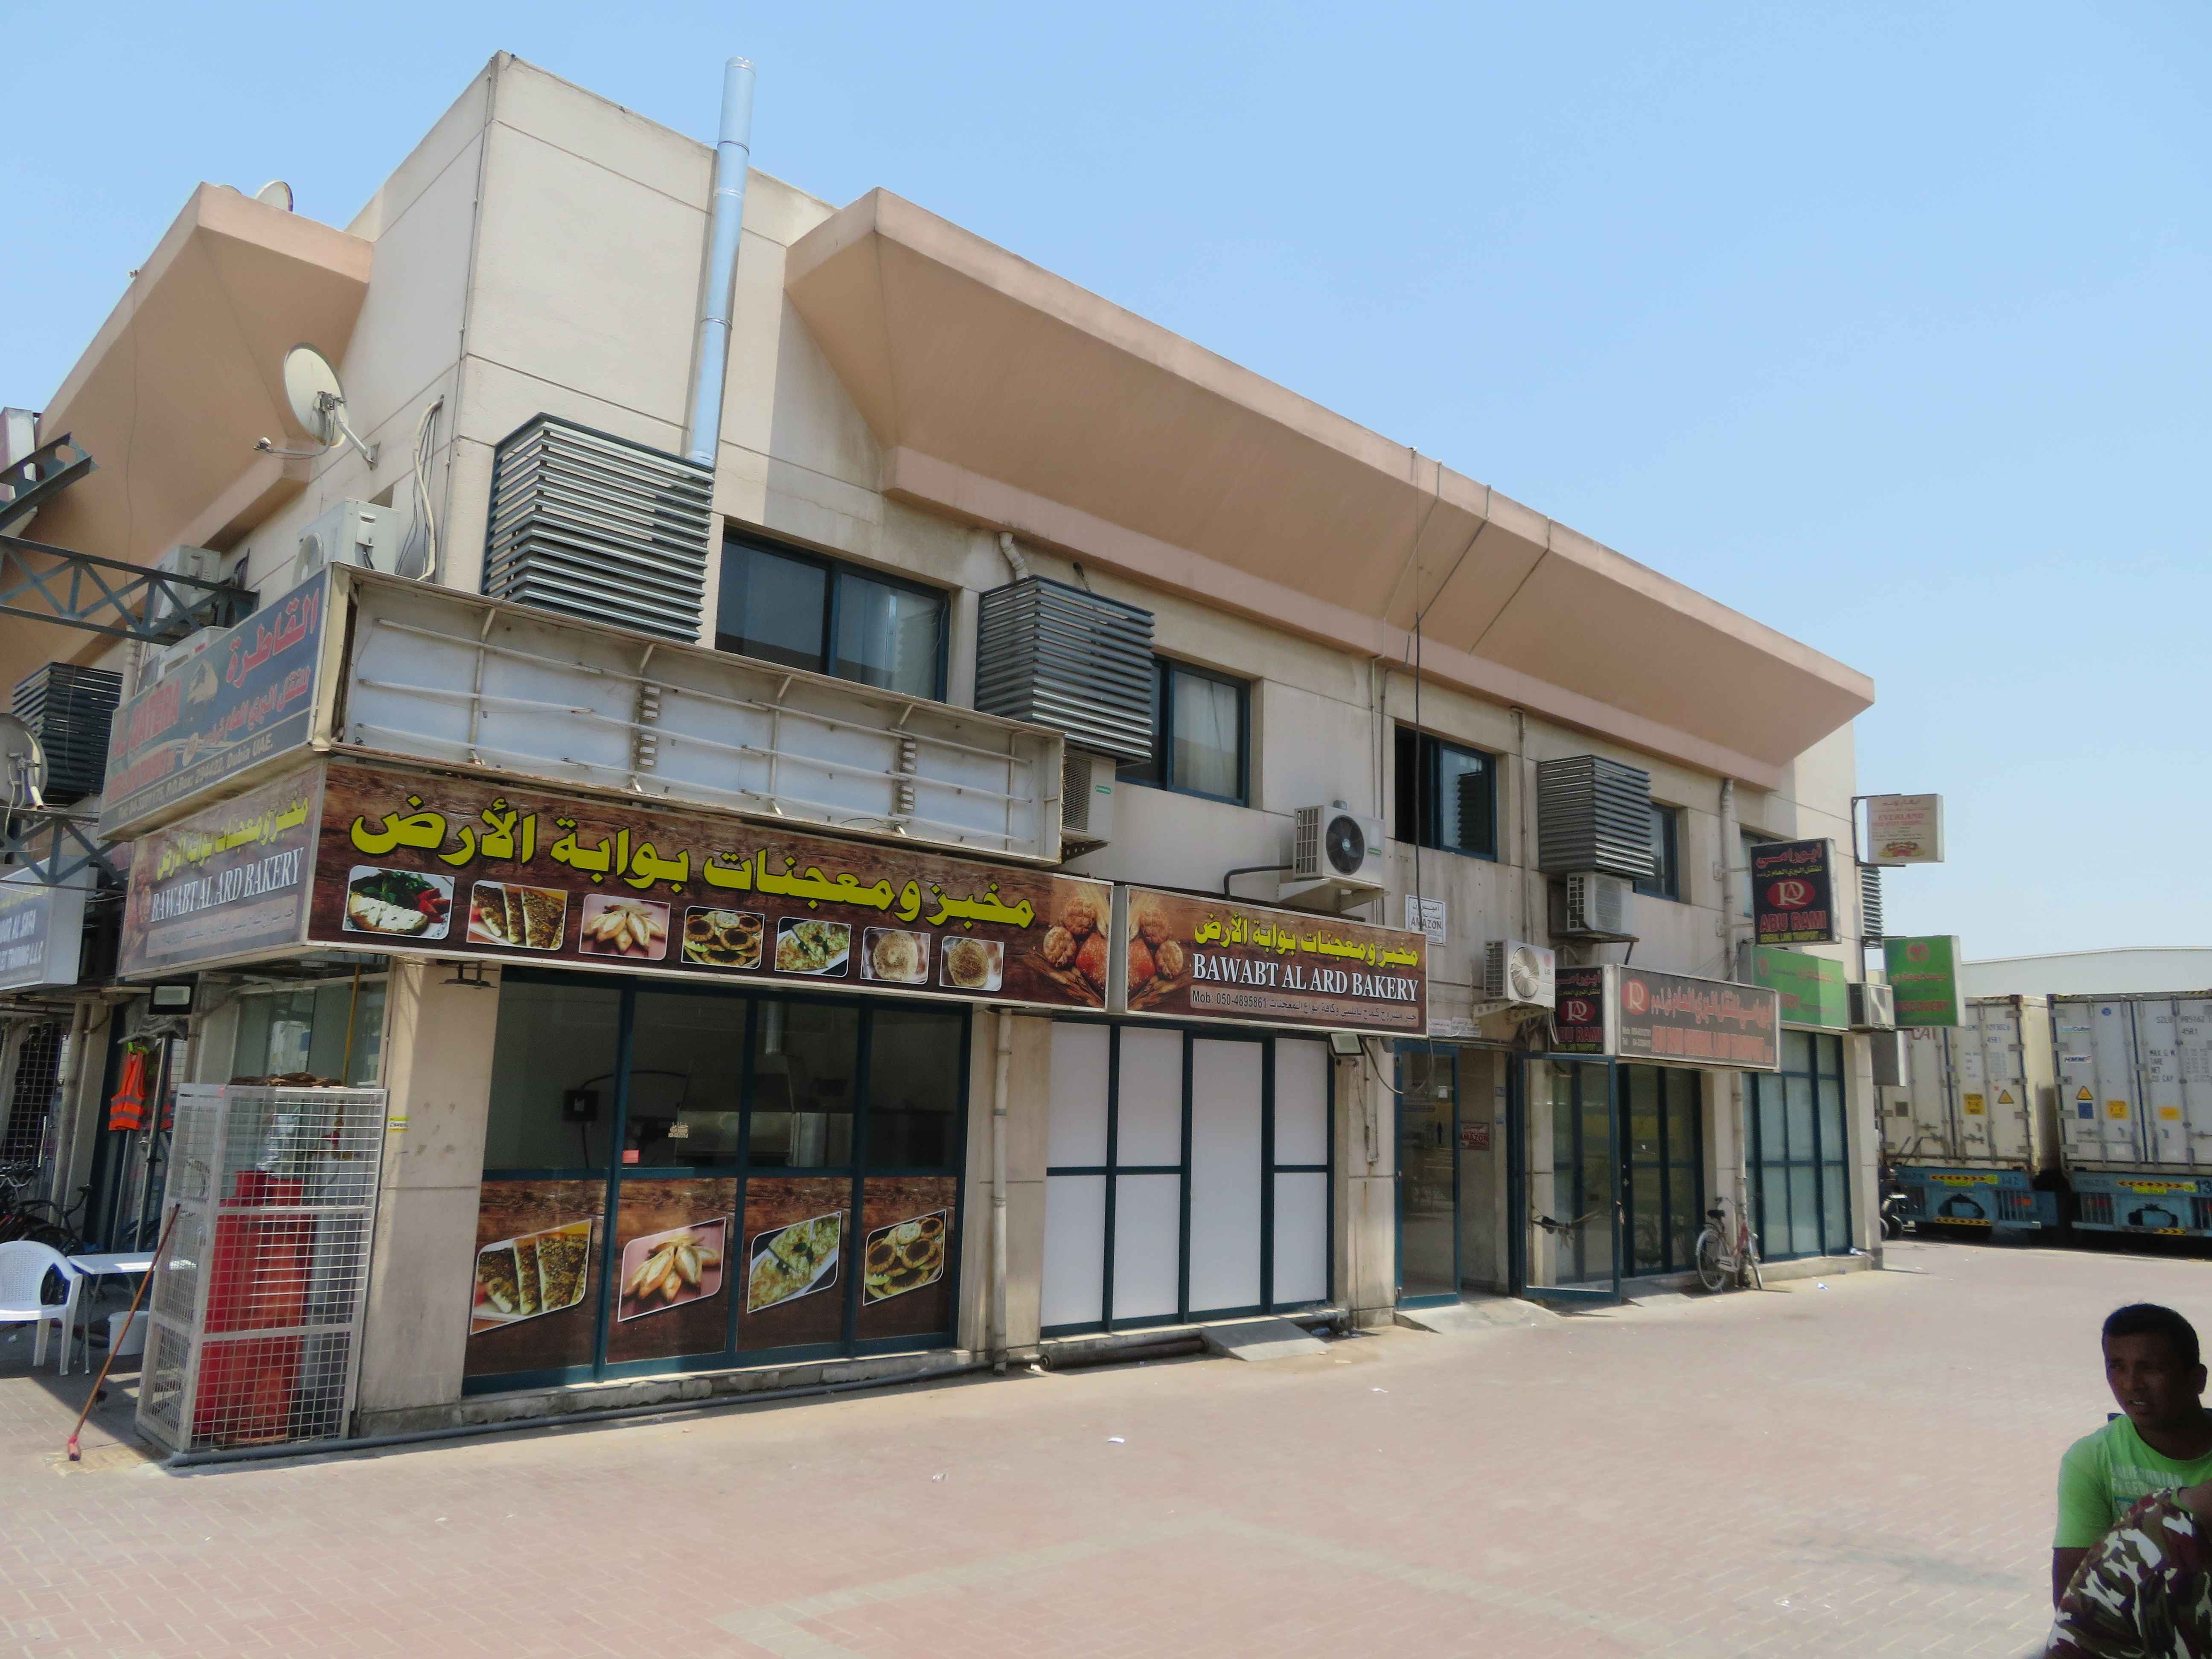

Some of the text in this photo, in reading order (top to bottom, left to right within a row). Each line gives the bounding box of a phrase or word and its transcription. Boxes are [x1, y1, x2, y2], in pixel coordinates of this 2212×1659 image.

[350, 794, 538, 866] الأرض
[550, 817, 690, 894] بوابة
[151, 847, 304, 923] BAWABT AL ARD BAKERY
[925, 882, 1036, 931] مخبز
[1194, 911, 1248, 948] الأرض
[1252, 918, 1297, 956] بوابة
[1759, 910, 1827, 933] ABU RAMI
[1378, 942, 1419, 968] مخبز
[1192, 953, 1419, 1001] BAWABT AL ARD BAKERY
[1192, 990, 1267, 1008] Mob: 050-4895861
